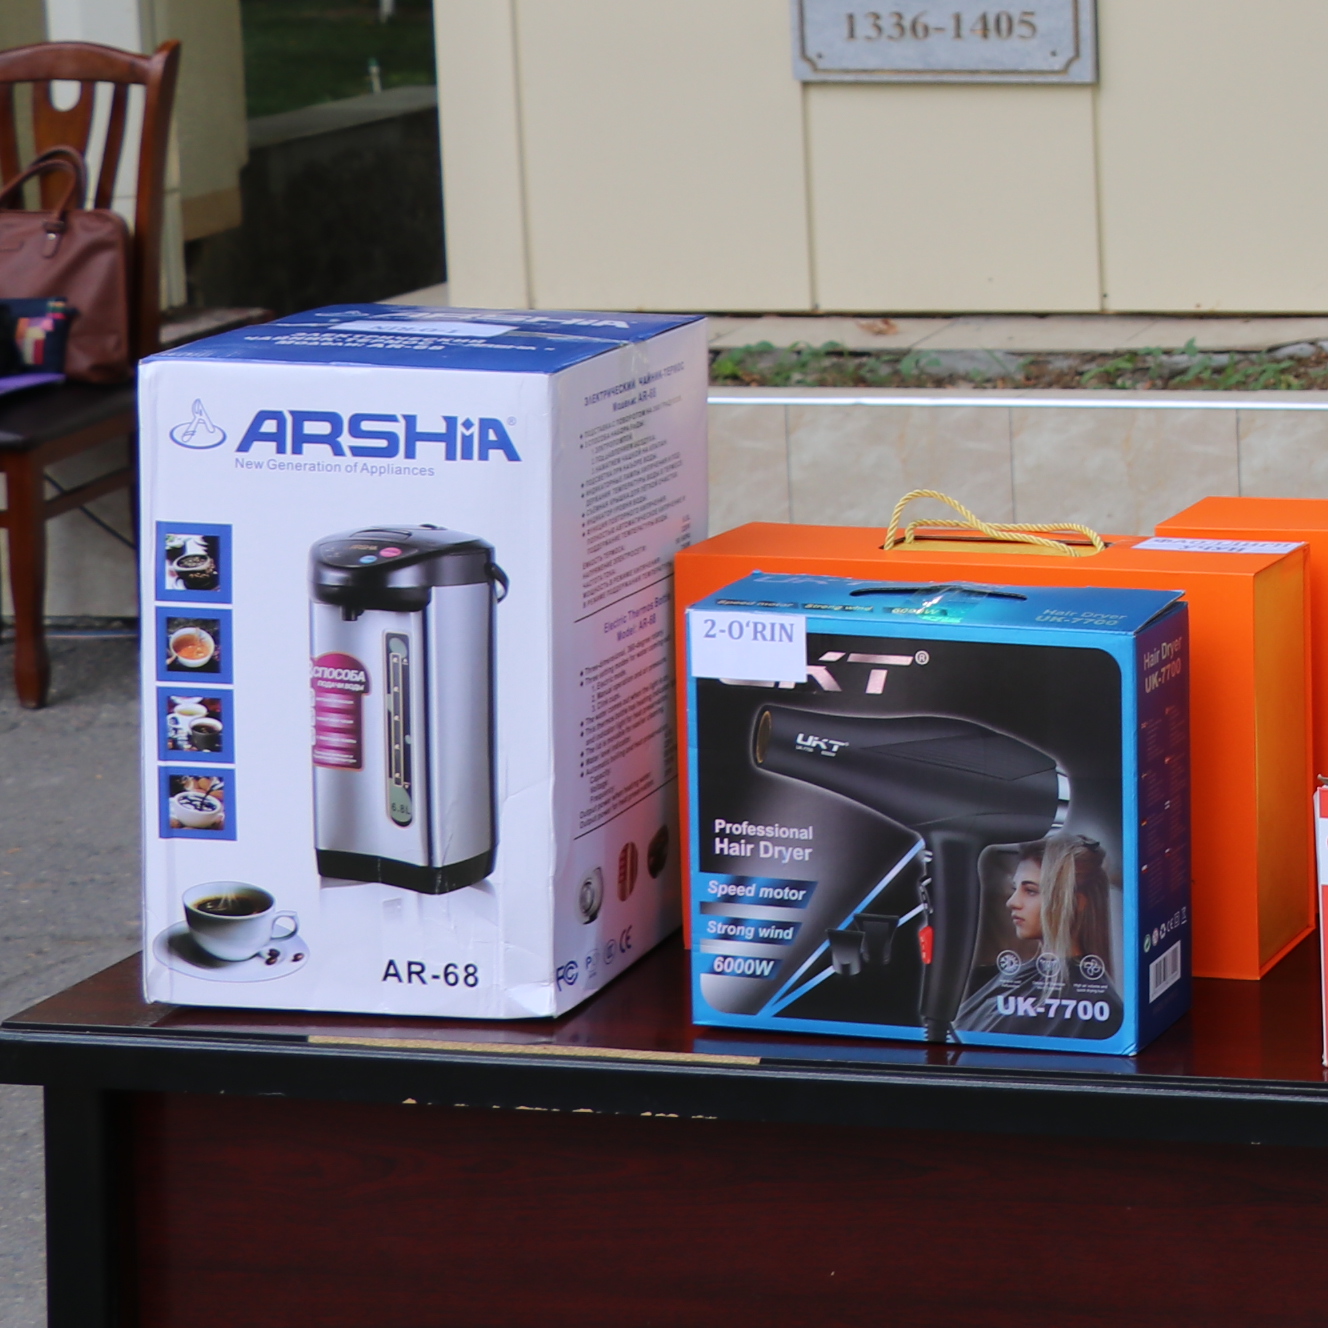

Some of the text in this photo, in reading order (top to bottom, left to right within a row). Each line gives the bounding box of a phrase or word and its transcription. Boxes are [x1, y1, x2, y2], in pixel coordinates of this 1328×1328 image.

[845, 10, 1038, 41] 1336-1405
[235, 458, 435, 477] New Generation of Appliances
[1035, 615, 1119, 627] UK-7700
[1043, 608, 1128, 621] Hair Dryer
[1143, 636, 1182, 671] Hair Dryer
[313, 666, 366, 682] СПОСОБА
[1145, 657, 1182, 693] UK-7700
[796, 733, 847, 752] UKT
[714, 819, 814, 841] Professional
[714, 837, 813, 864] Hair Dryer
[707, 880, 807, 901] Speed motor
[707, 920, 795, 941] Strong wind
[382, 958, 480, 988] AR-68
[713, 956, 775, 977] 6000W
[996, 995, 1110, 1022] UK-7700
